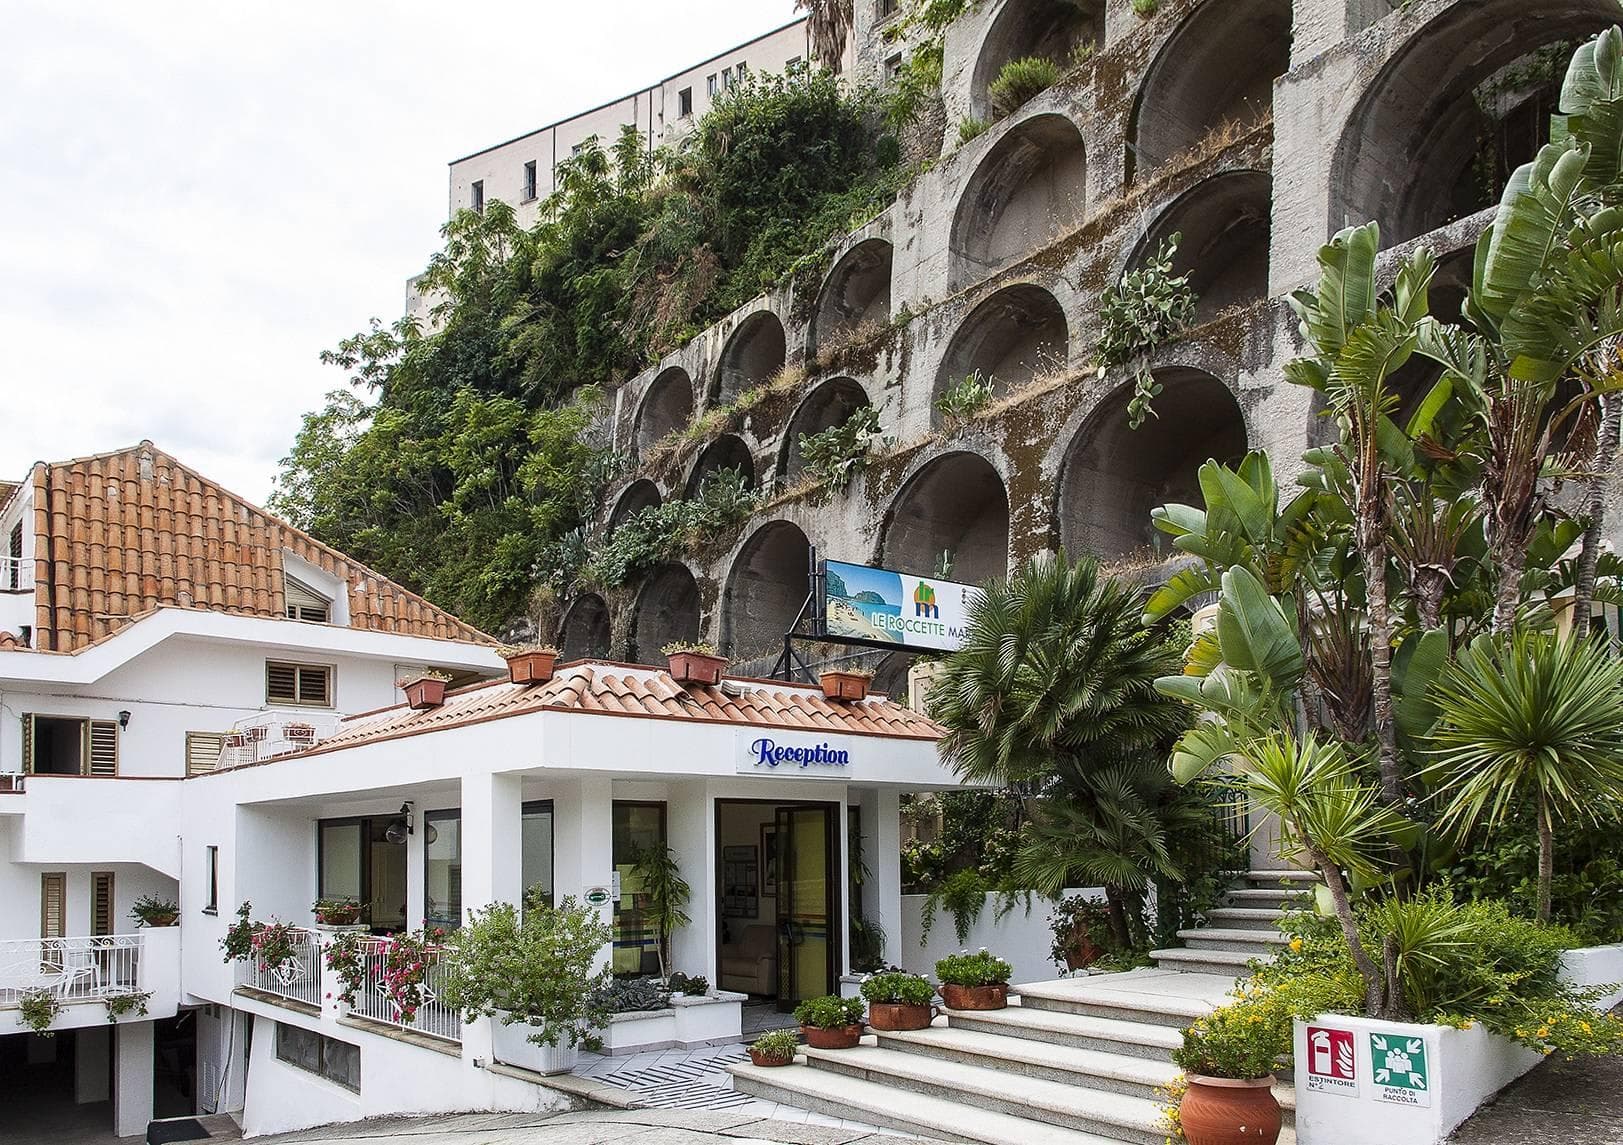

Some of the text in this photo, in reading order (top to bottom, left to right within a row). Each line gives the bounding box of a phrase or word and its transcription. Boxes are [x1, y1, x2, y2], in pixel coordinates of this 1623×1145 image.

[873, 614, 885, 628] LE
[889, 616, 945, 636] ROCCETTE
[751, 738, 849, 767] Reception
[1308, 1075, 1355, 1088] ESTINTORE
[1384, 1087, 1407, 1096] PUNTO
[1383, 1093, 1418, 1104] RACCOLTA
